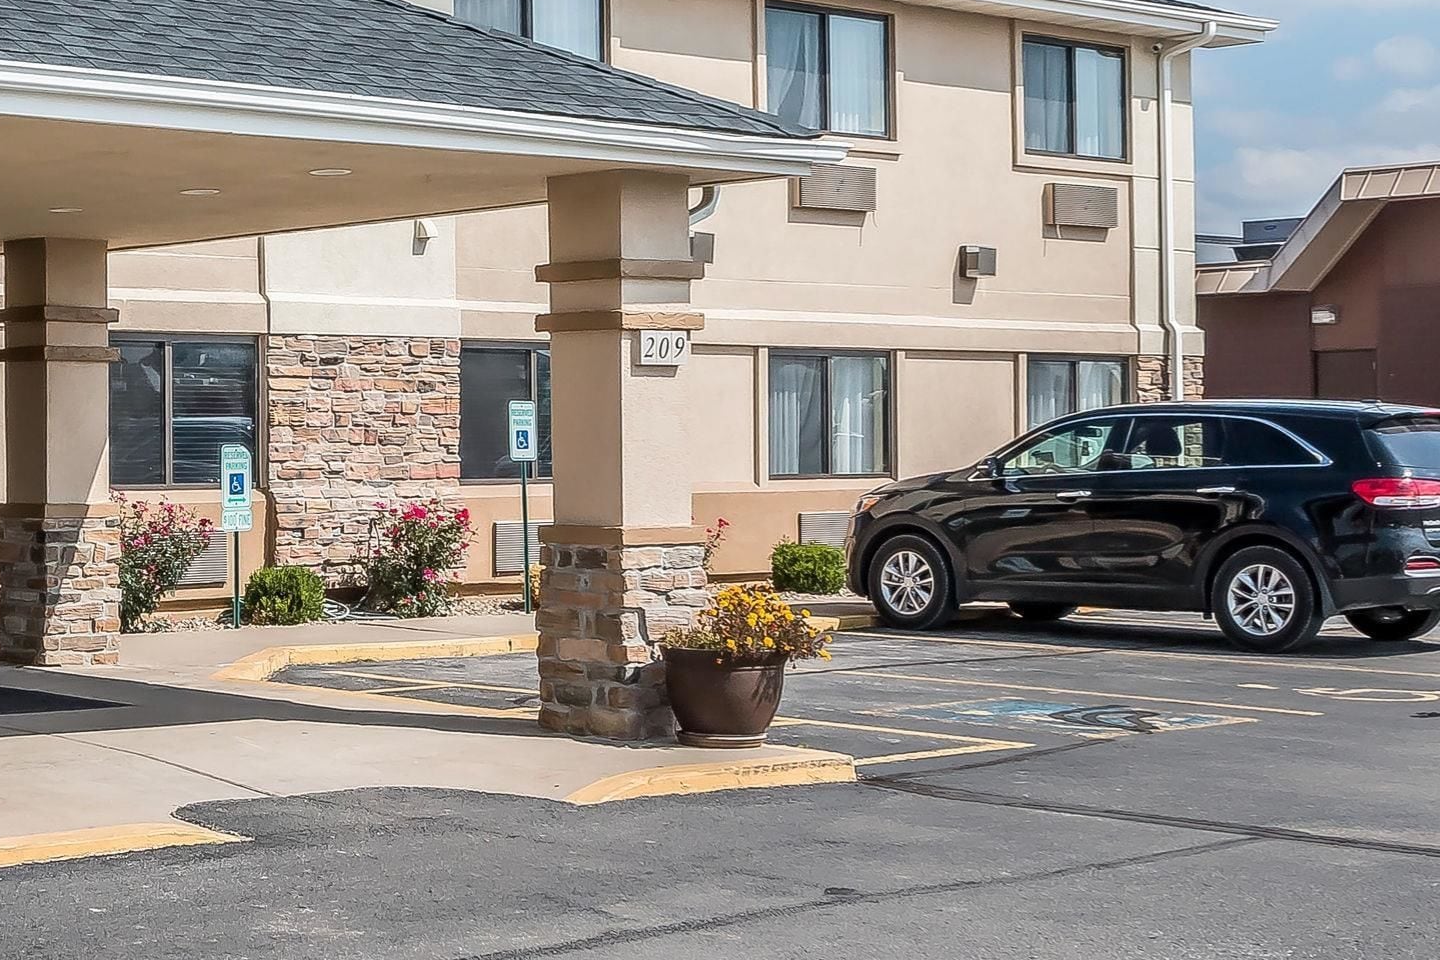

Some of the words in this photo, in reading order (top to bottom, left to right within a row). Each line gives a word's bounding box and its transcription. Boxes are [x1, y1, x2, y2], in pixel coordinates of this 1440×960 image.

[643, 336, 685, 359] 209
[225, 461, 248, 471] PARKING
[238, 514, 251, 526] FINE
